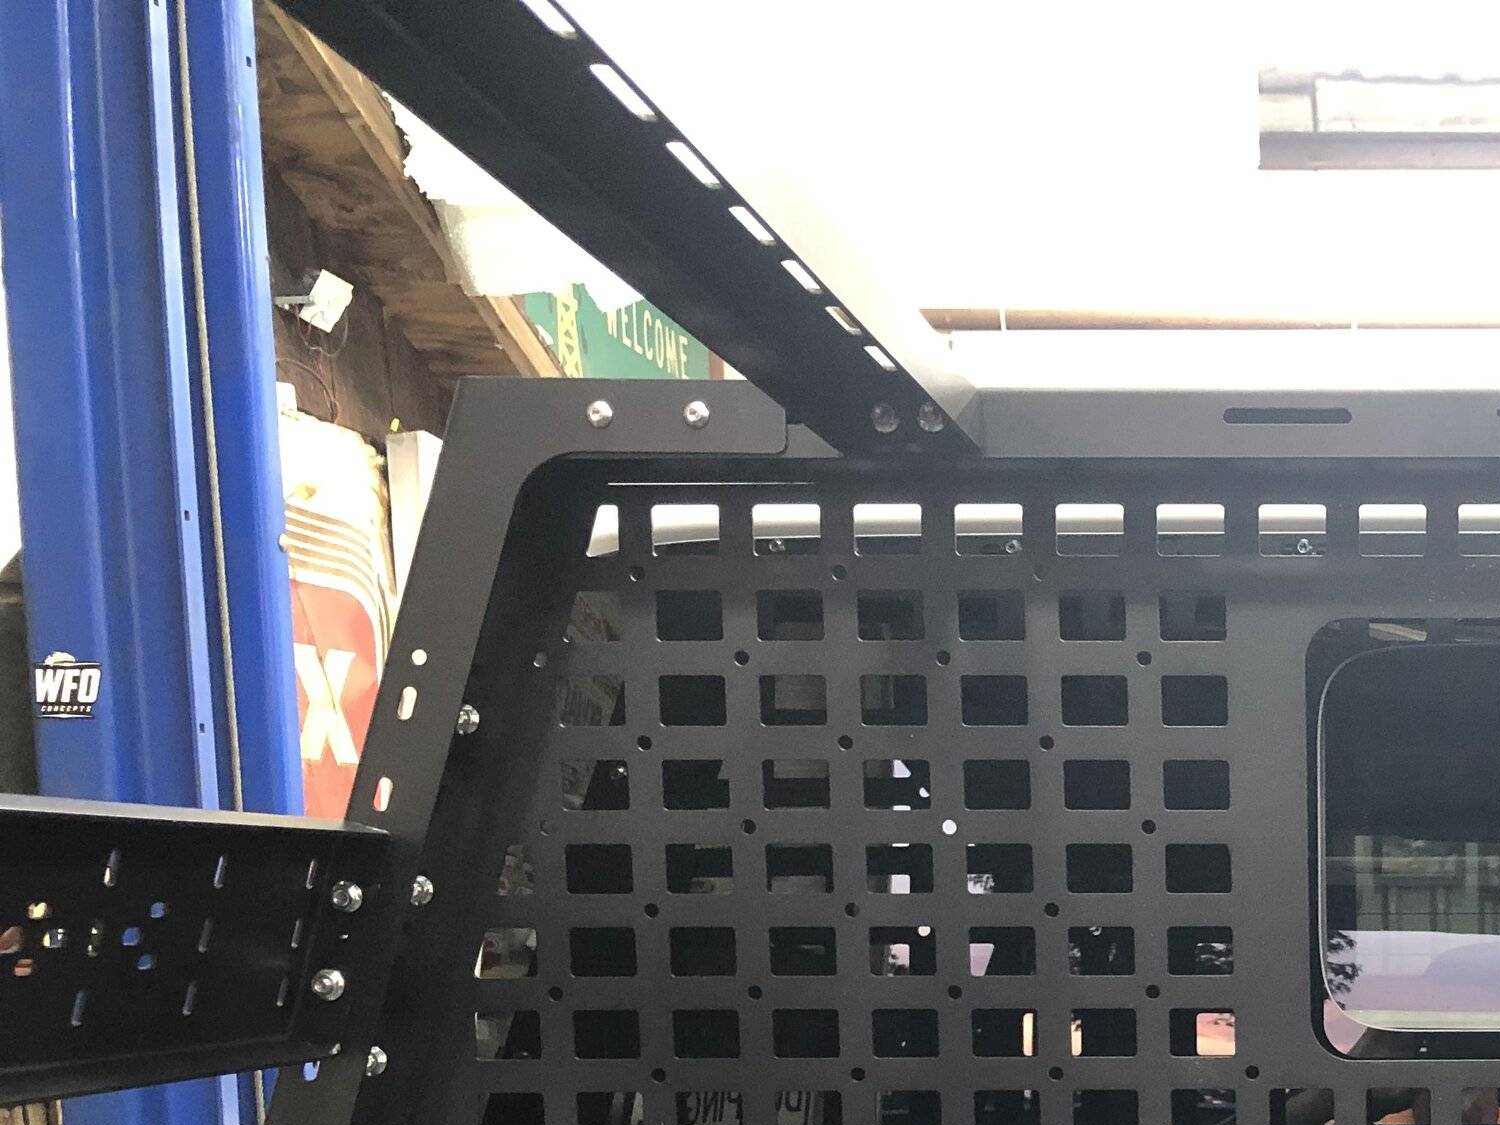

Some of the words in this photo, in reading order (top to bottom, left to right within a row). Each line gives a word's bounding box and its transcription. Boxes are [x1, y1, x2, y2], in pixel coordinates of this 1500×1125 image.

[606, 301, 689, 380] WELCOME
[35, 668, 101, 703] WFO
[41, 705, 92, 713] CONCEPTS
